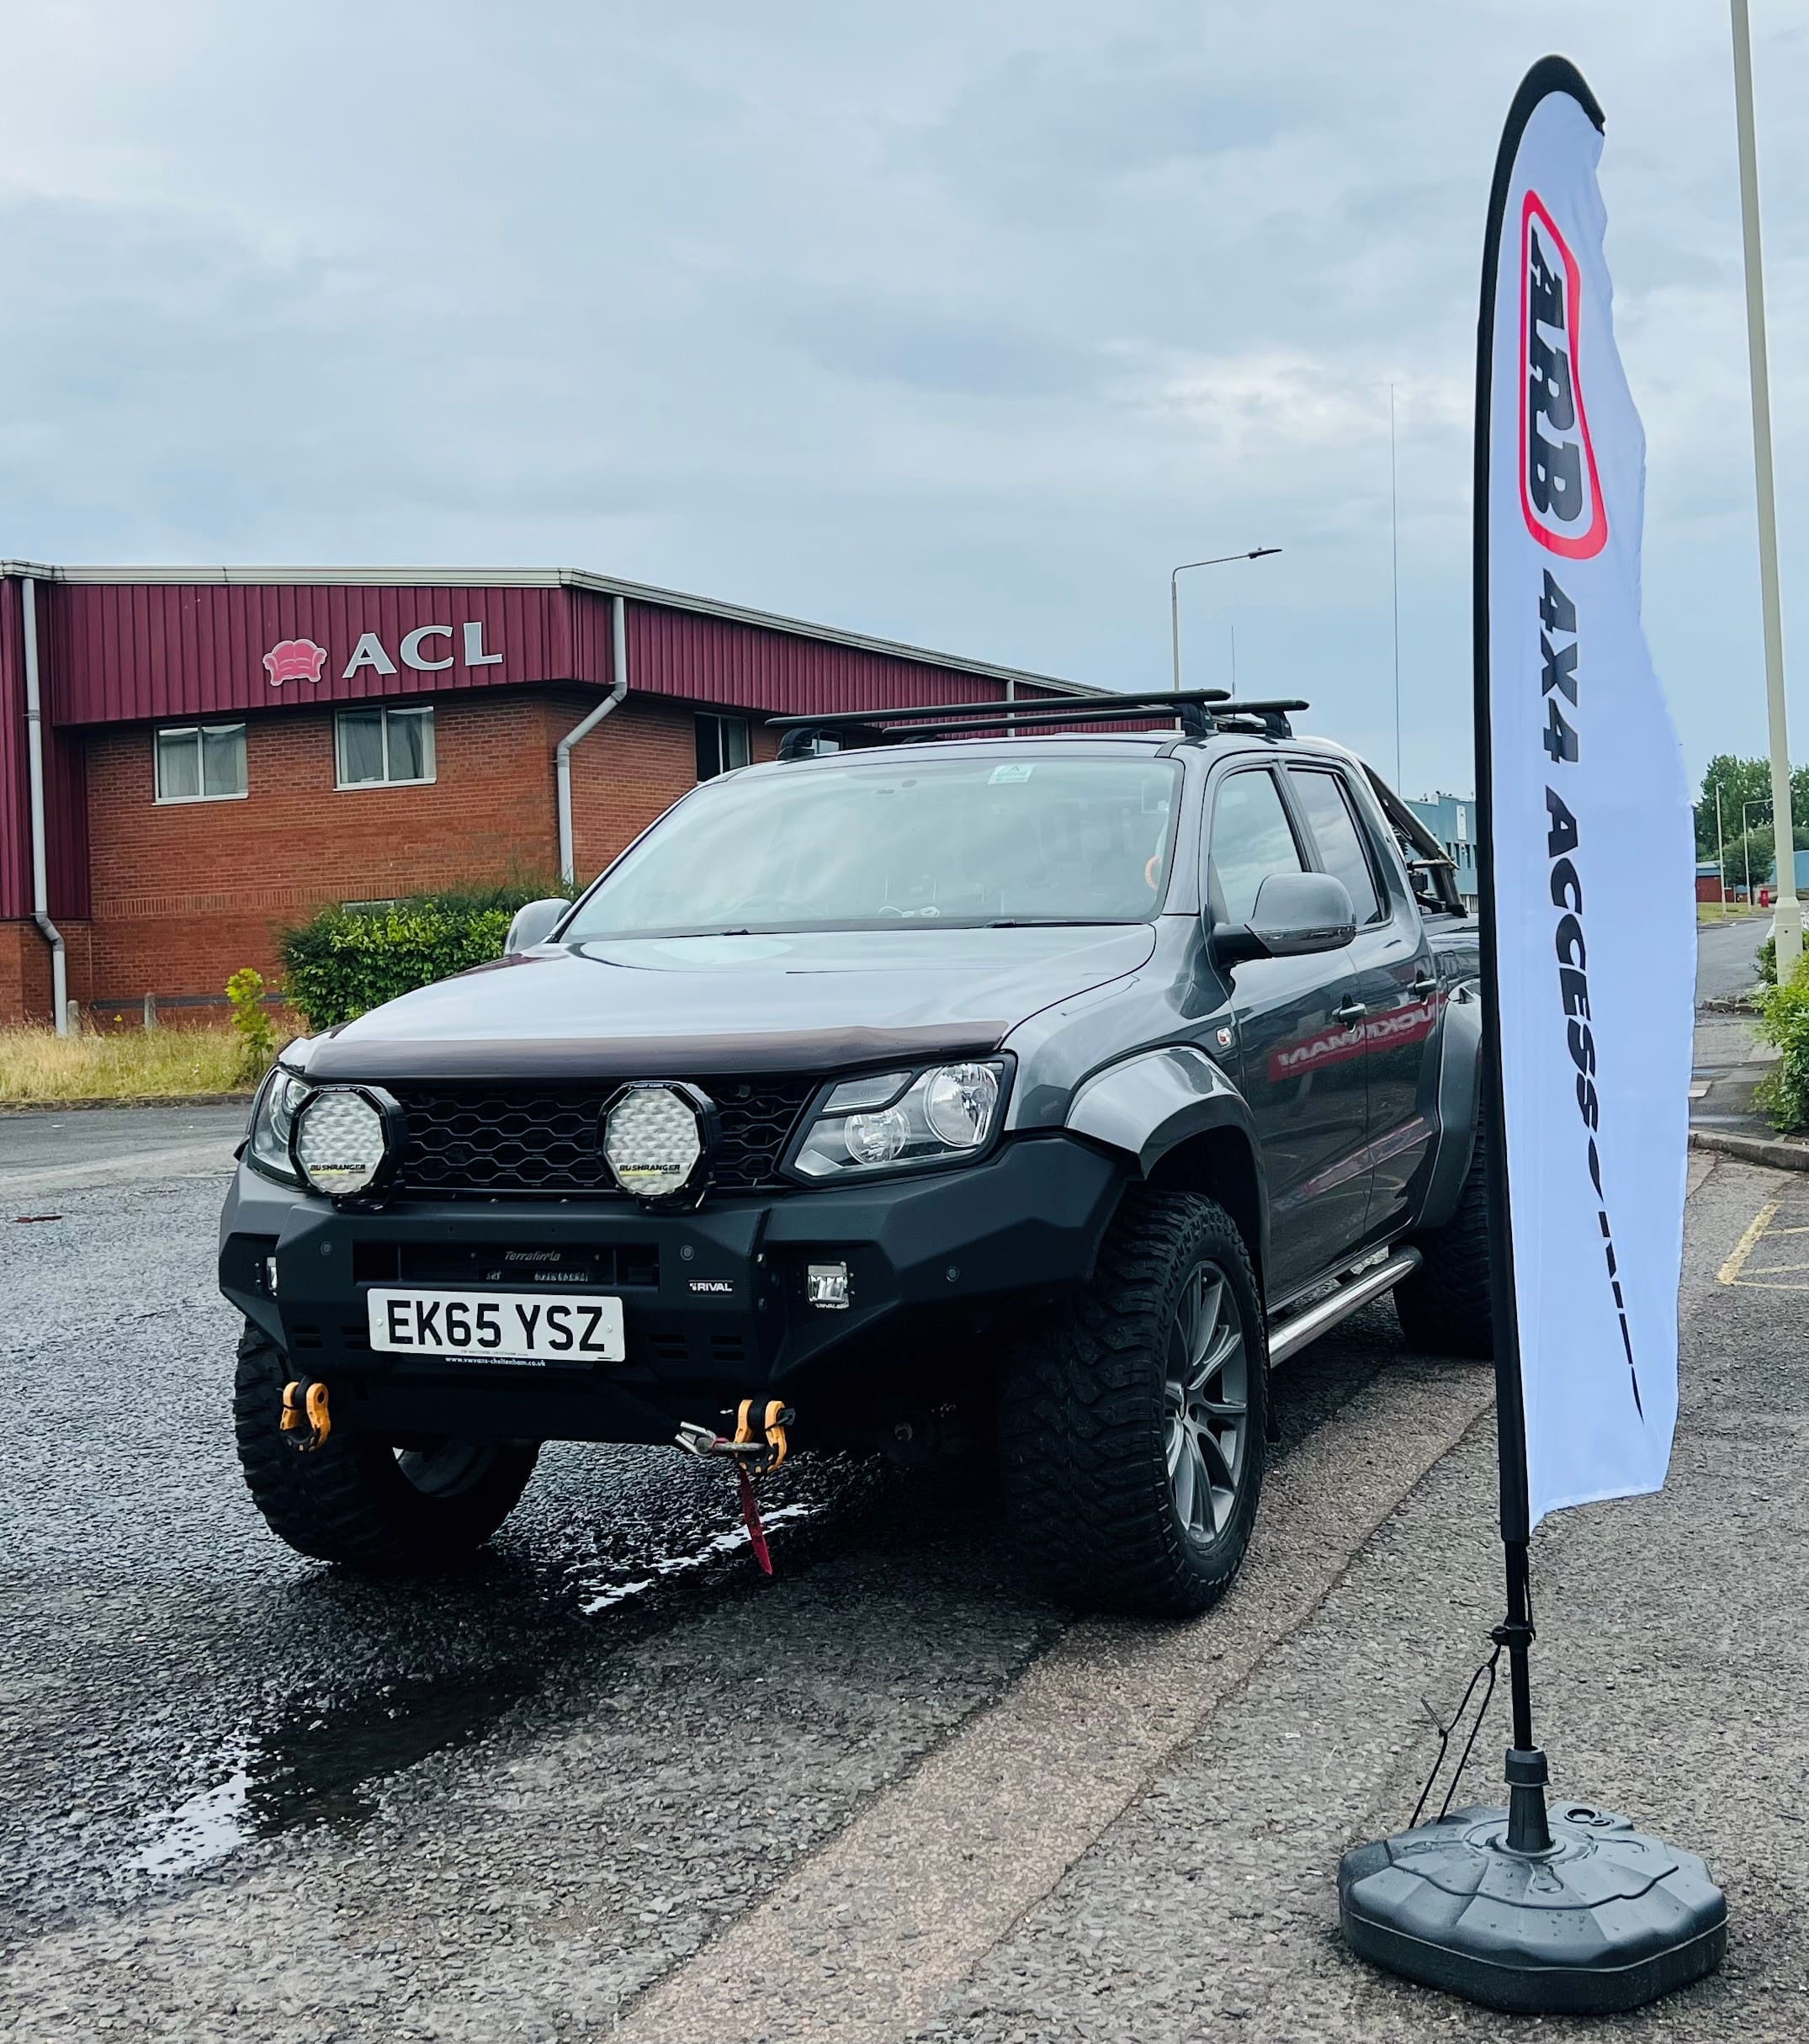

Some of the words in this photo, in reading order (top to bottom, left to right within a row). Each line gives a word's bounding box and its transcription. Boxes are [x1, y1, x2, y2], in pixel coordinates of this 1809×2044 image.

[1529, 226, 1583, 522] ARB
[342, 621, 503, 679] ACL
[1539, 568, 1579, 764] 4X4
[698, 1282, 733, 1292] RIVAL
[386, 1299, 502, 1348] EK65
[515, 1303, 605, 1352] YSZ
